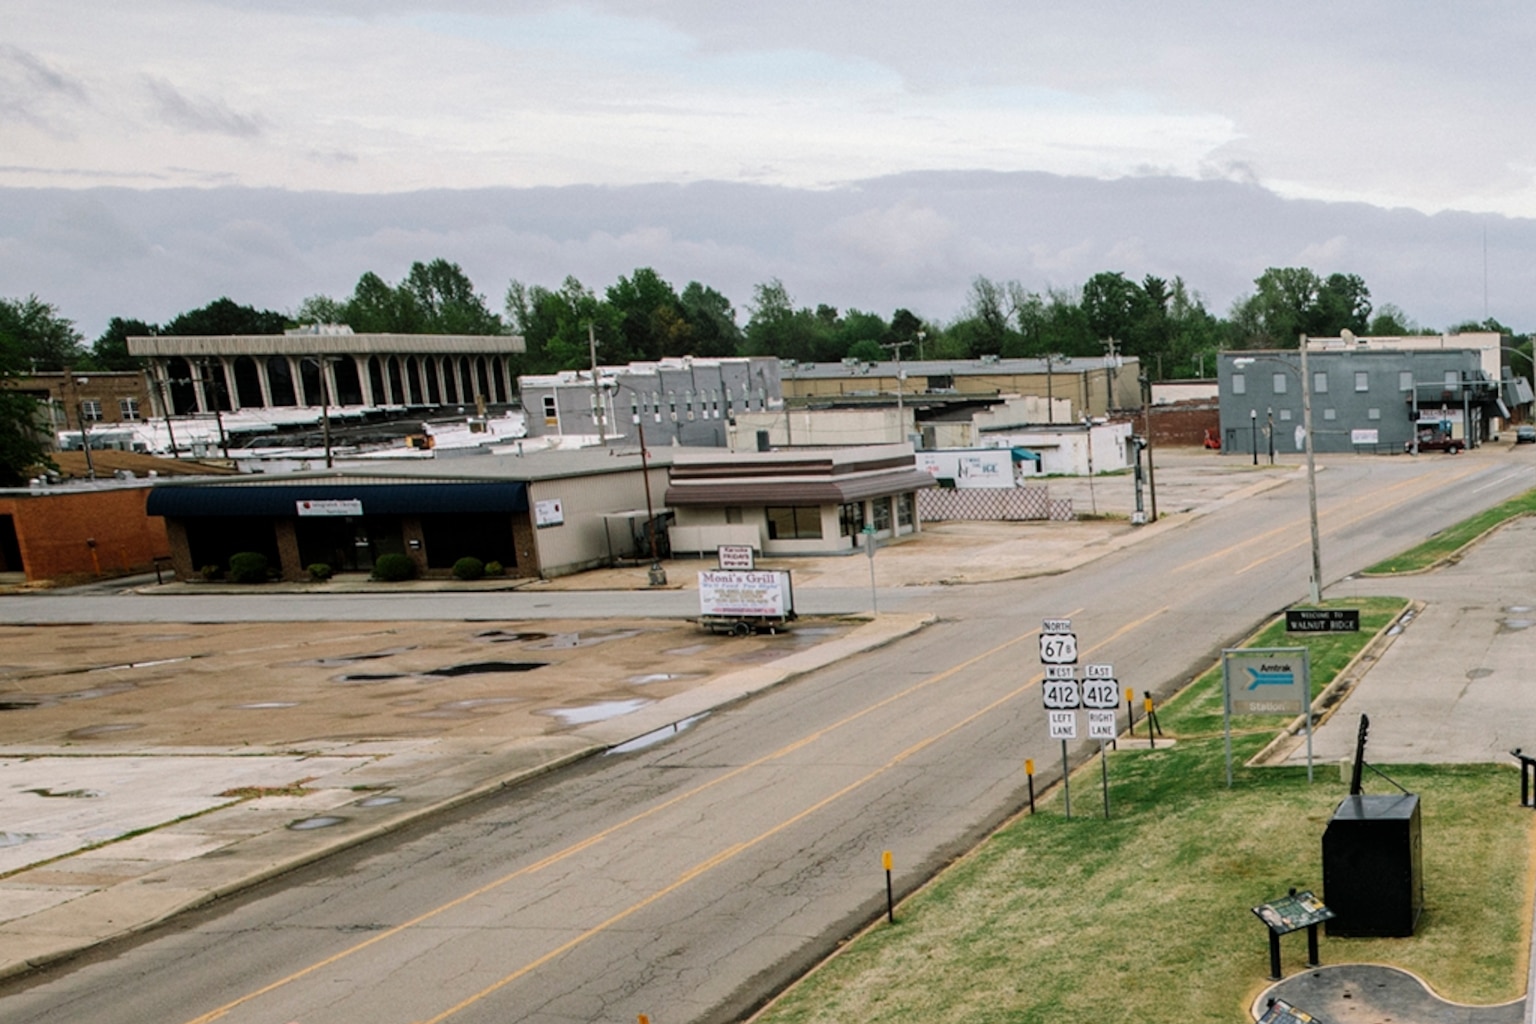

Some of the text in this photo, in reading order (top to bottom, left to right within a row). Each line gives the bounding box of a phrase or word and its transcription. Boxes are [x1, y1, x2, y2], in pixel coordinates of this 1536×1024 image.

[703, 573, 775, 583] Moni's Grill
[1291, 621, 1354, 630] WALNUT RIDGE
[1045, 641, 1064, 657] 67
[1048, 668, 1071, 676] WEST
[1089, 667, 1109, 675] EAST
[1260, 664, 1291, 672] Amtrak
[1048, 687, 1073, 702] 412
[1087, 687, 1112, 702] 412
[1250, 702, 1285, 711] Station
[1052, 714, 1072, 722] LEFT
[1090, 713, 1113, 722] RIGHT
[1053, 726, 1073, 735] LANE
[1092, 726, 1112, 735] LANE
